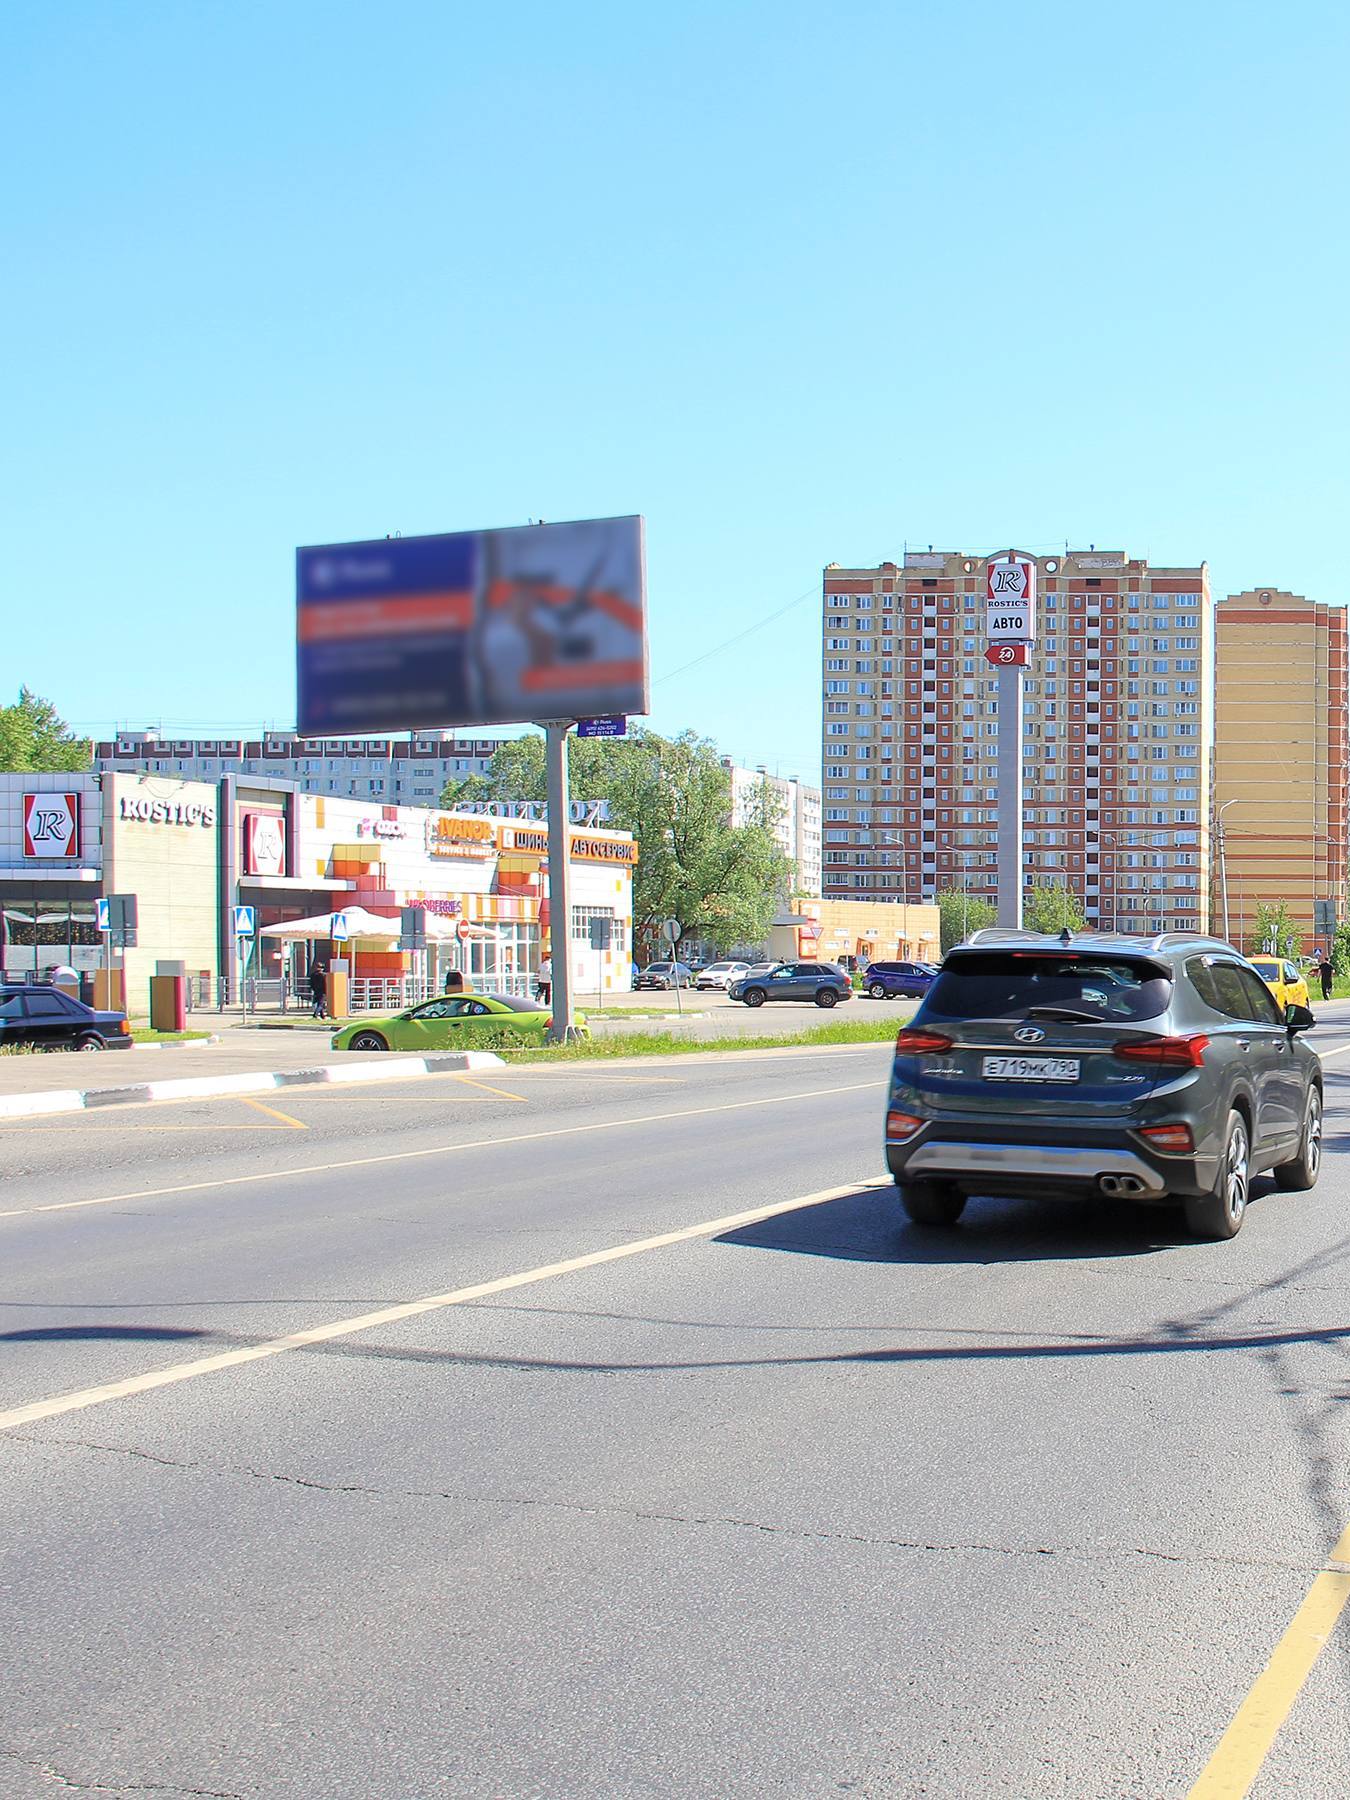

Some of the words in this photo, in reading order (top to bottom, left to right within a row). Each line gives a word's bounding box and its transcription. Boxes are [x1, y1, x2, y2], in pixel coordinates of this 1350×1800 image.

[993, 617, 1023, 629] АВТО
[121, 798, 217, 827] ROSTIC'S
[571, 838, 635, 861] АВТОСЕРВИС
